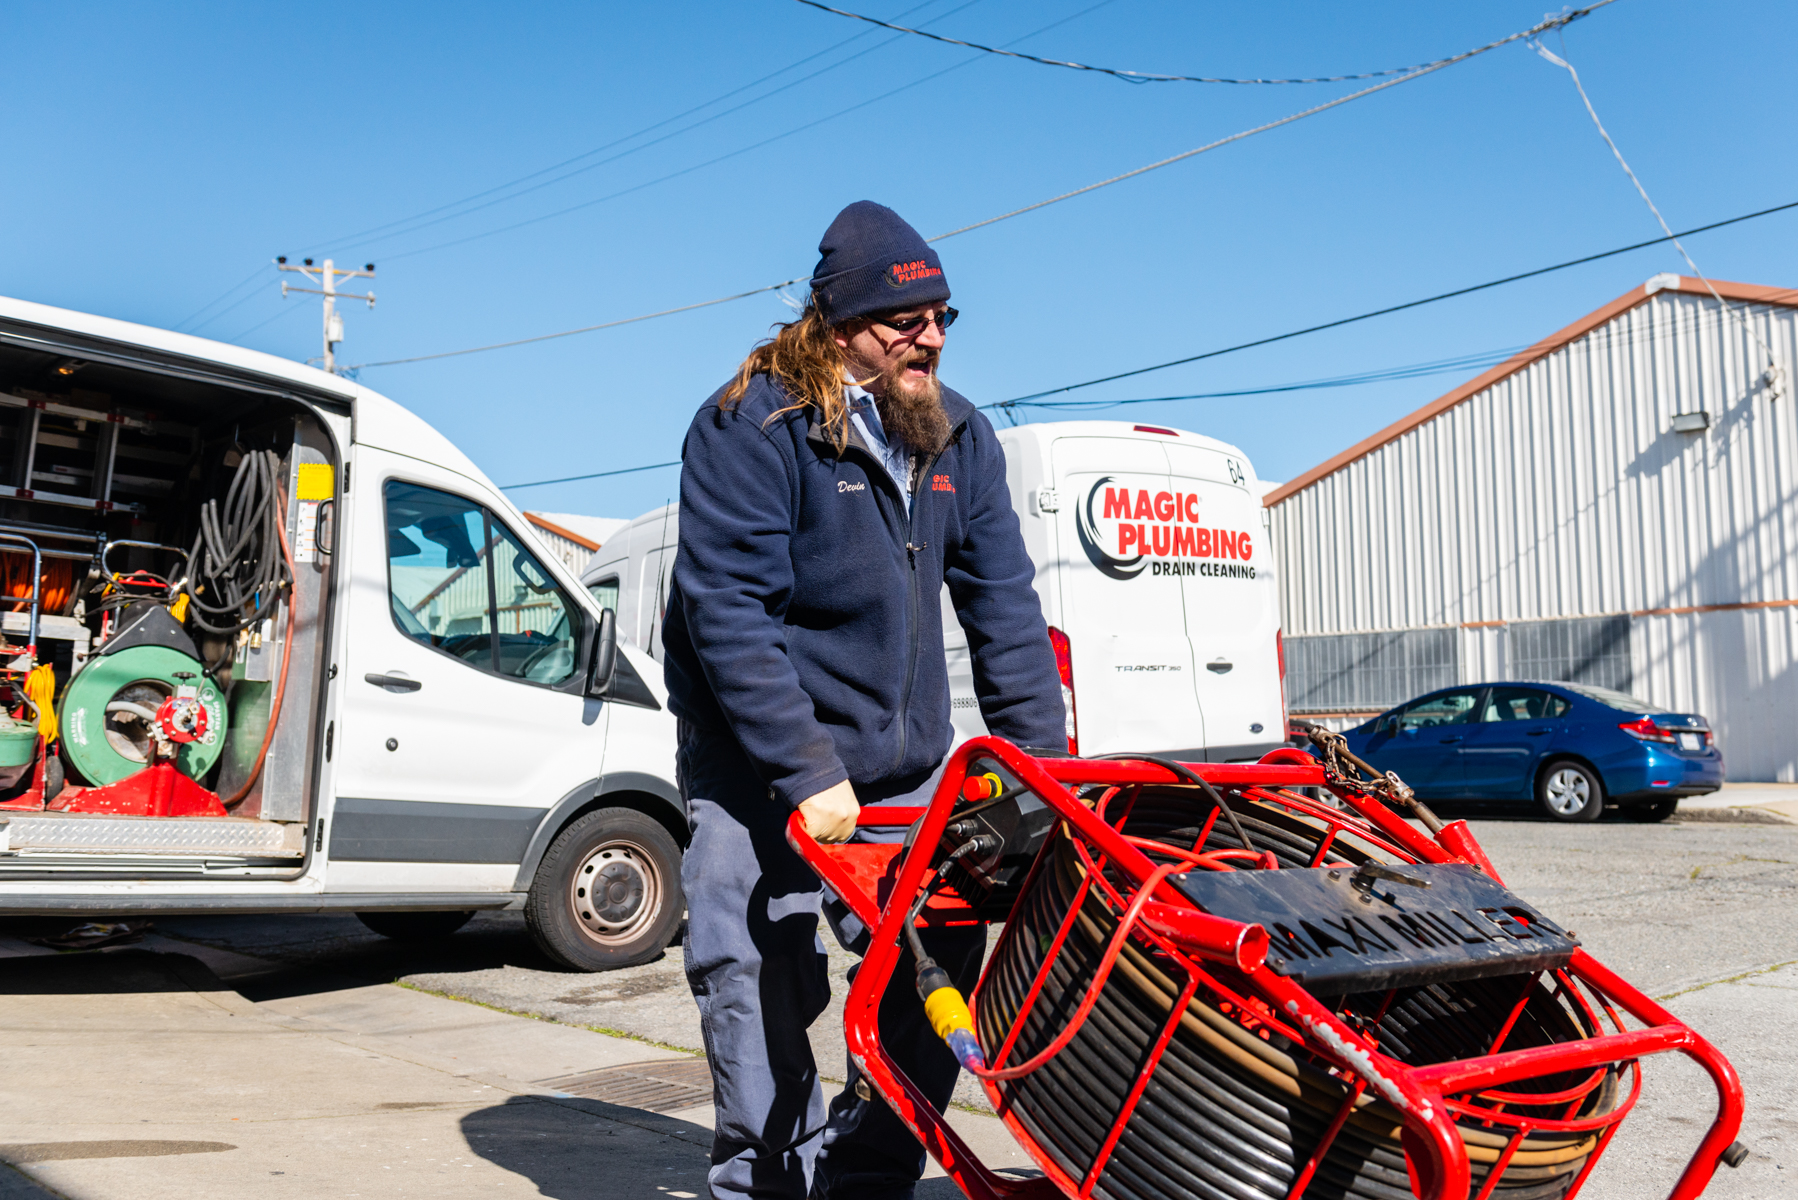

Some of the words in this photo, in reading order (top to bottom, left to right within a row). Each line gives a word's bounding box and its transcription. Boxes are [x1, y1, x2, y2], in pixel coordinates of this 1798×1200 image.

[893, 260, 926, 275] MAGIC
[1227, 458, 1245, 486] 64
[837, 480, 865, 493] Devin
[1103, 487, 1199, 523] MAGIC
[1118, 523, 1253, 561] PLUMBING
[1152, 562, 1196, 576] DRAIN
[1200, 563, 1256, 579] CLEANING
[1267, 915, 1399, 960] MAXI
[1378, 906, 1561, 948] MILLER
